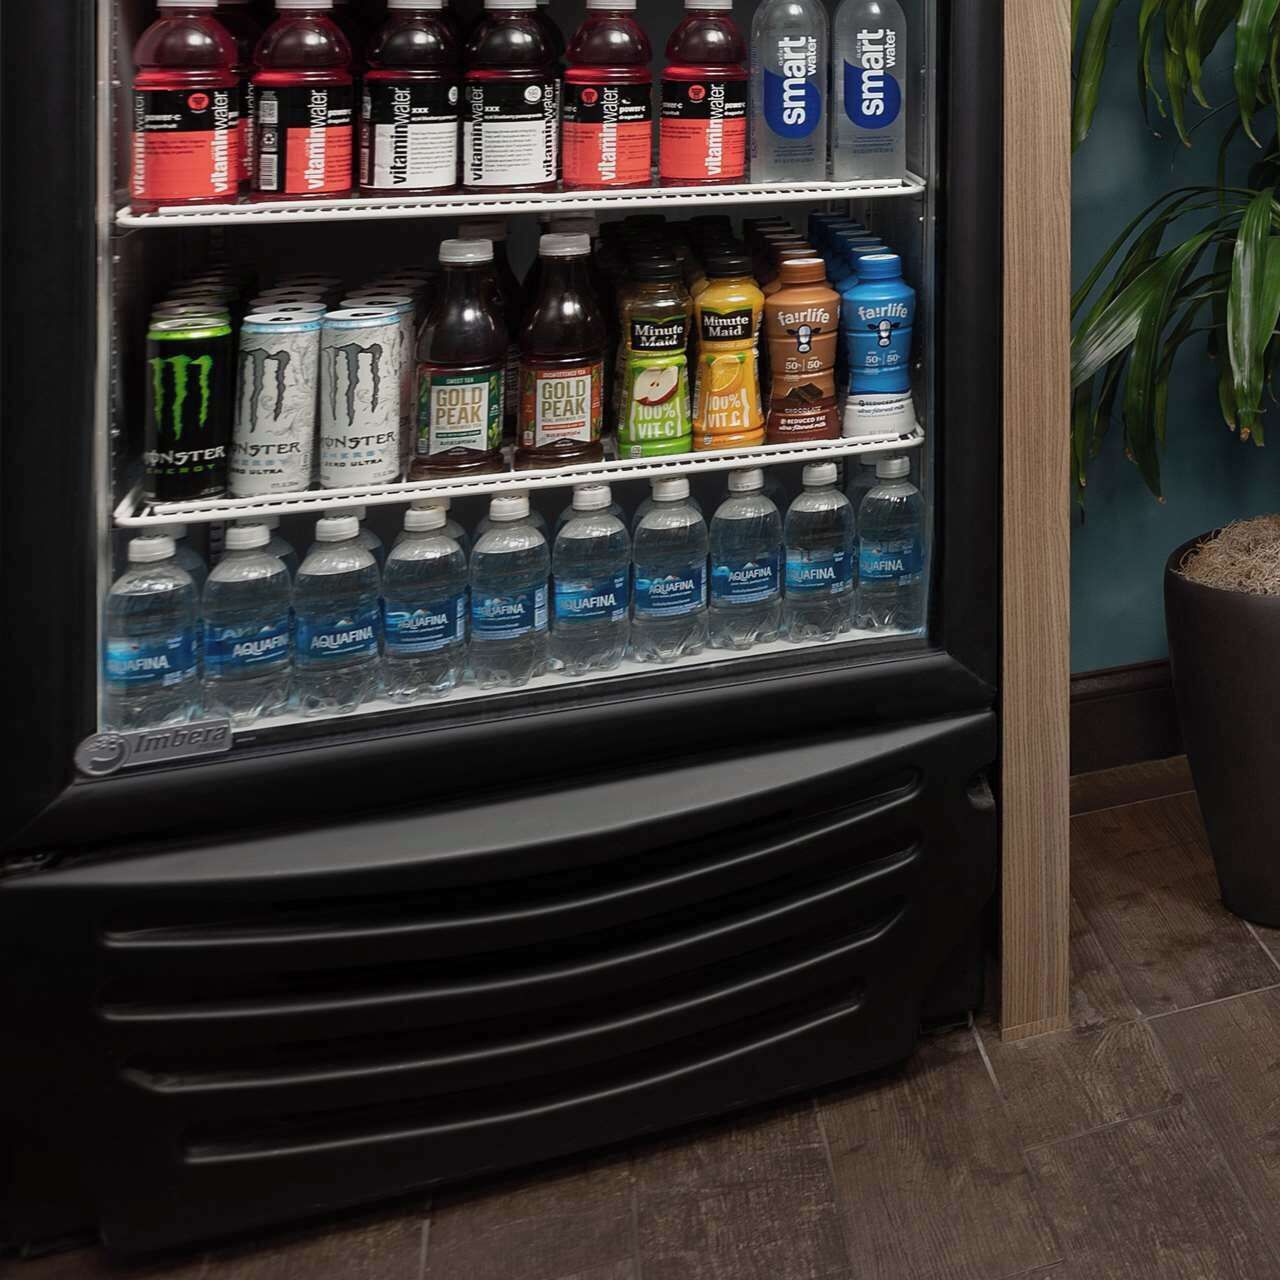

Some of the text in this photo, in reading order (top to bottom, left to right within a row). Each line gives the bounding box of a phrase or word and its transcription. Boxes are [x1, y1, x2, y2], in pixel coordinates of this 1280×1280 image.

[807, 36, 818, 76] water
[885, 28, 897, 68] water
[778, 36, 807, 126] smart
[857, 28, 885, 116] smart
[635, 324, 683, 336] Minute
[704, 315, 749, 327] Minute
[640, 335, 678, 347] Maid
[709, 326, 742, 337] Maid
[437, 387, 483, 407] GOLD
[542, 380, 586, 400] GOLD
[542, 398, 585, 418] PEAK
[708, 393, 741, 410] 100%
[436, 405, 482, 425] PEAK
[638, 405, 676, 421] 100%
[728, 566, 772, 583] AQUAFINA
[649, 579, 695, 596] AQUAFINA
[398, 613, 448, 631] AQUAFINA
[232, 633, 289, 658] AQUAFIN
[310, 625, 373, 649] AQUAFINA
[133, 725, 229, 754] Imbera
